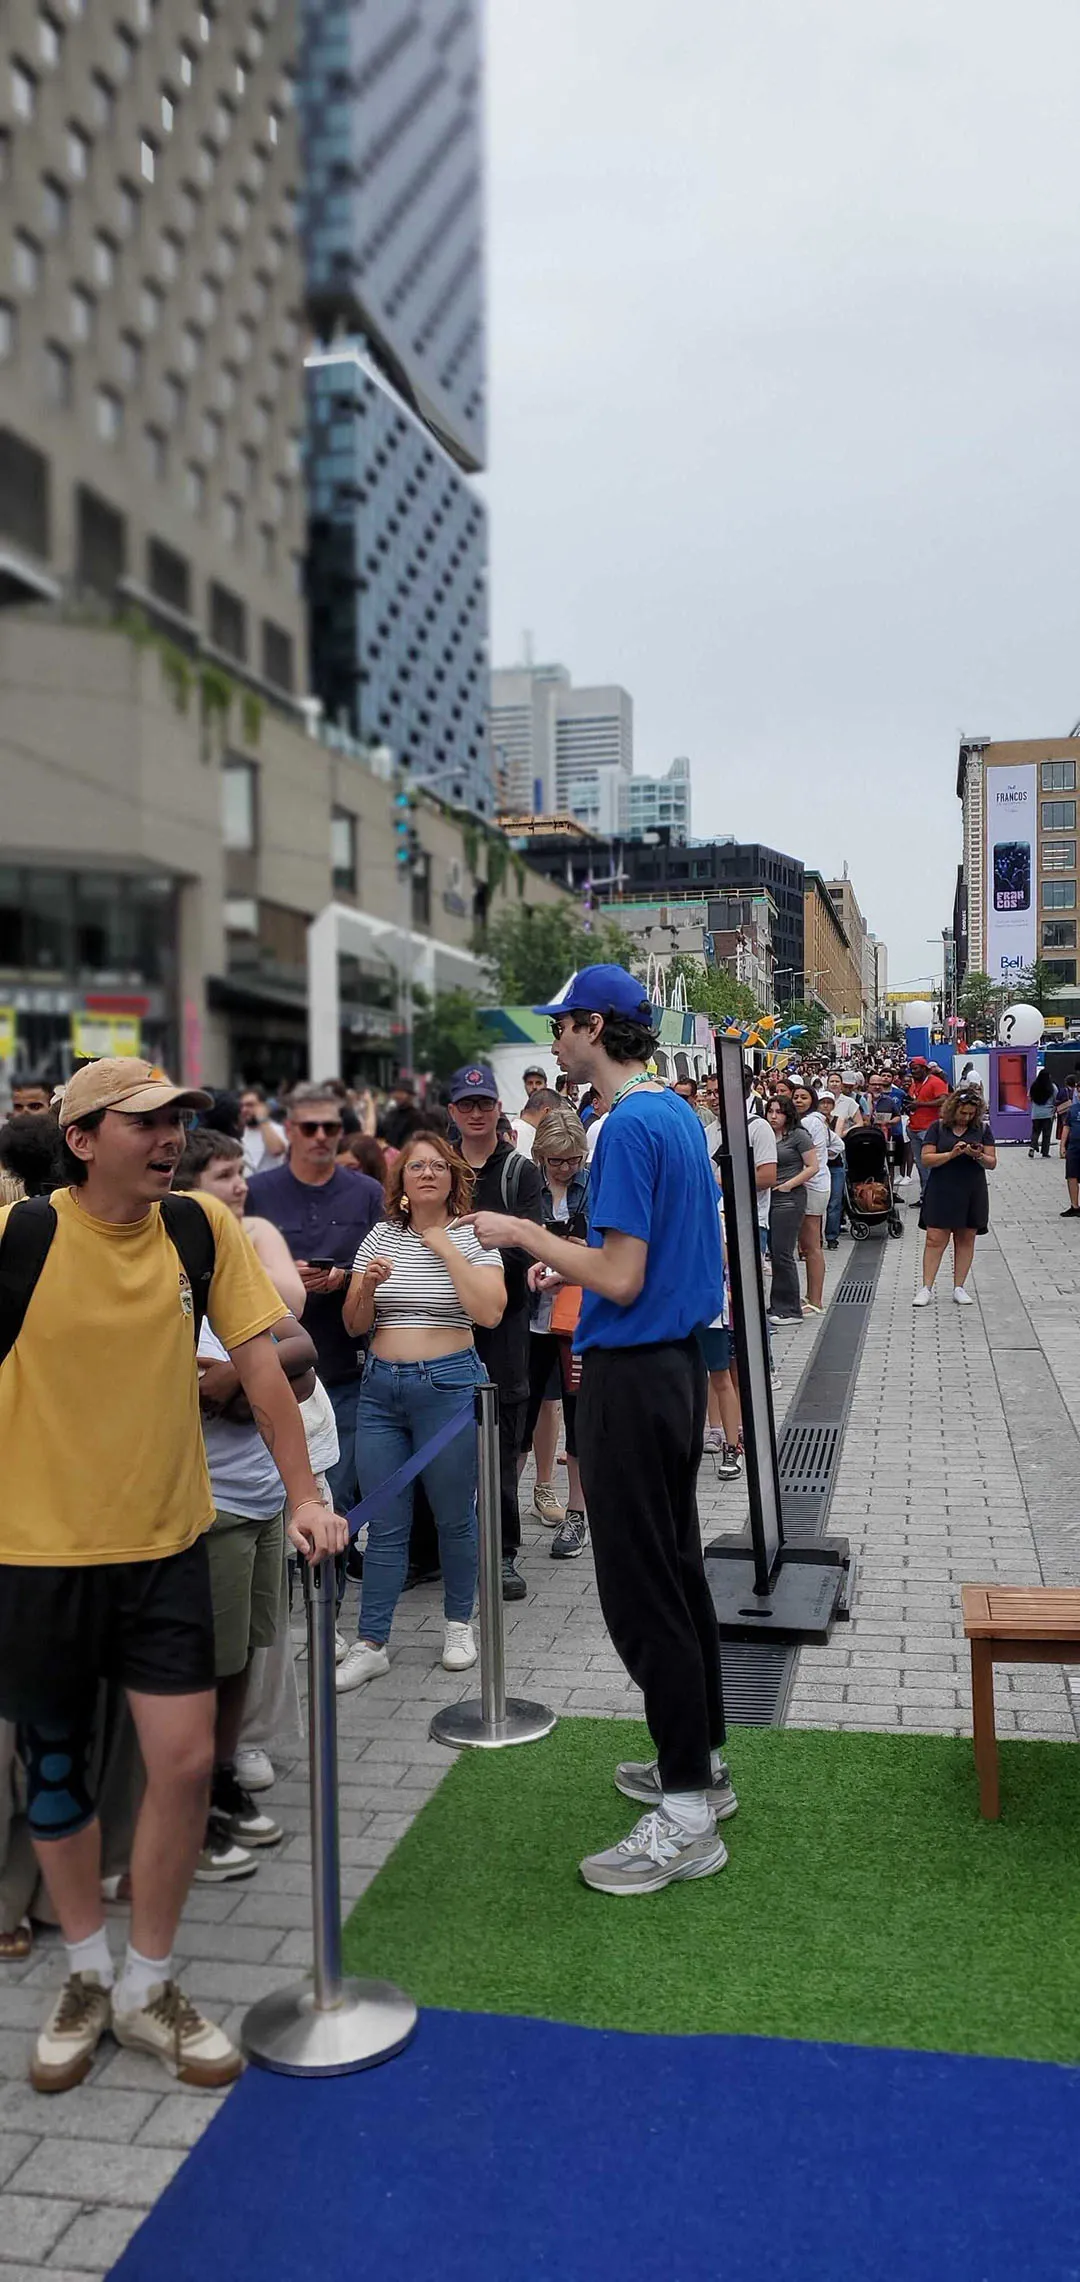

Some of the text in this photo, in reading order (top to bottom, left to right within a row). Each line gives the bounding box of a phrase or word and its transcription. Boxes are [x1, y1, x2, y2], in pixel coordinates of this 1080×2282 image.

[996, 791, 1028, 802] FRANCOS
[996, 900, 1018, 909] COS
[1000, 955, 1023, 968] Bell
[1003, 1015, 1016, 1039] ?
